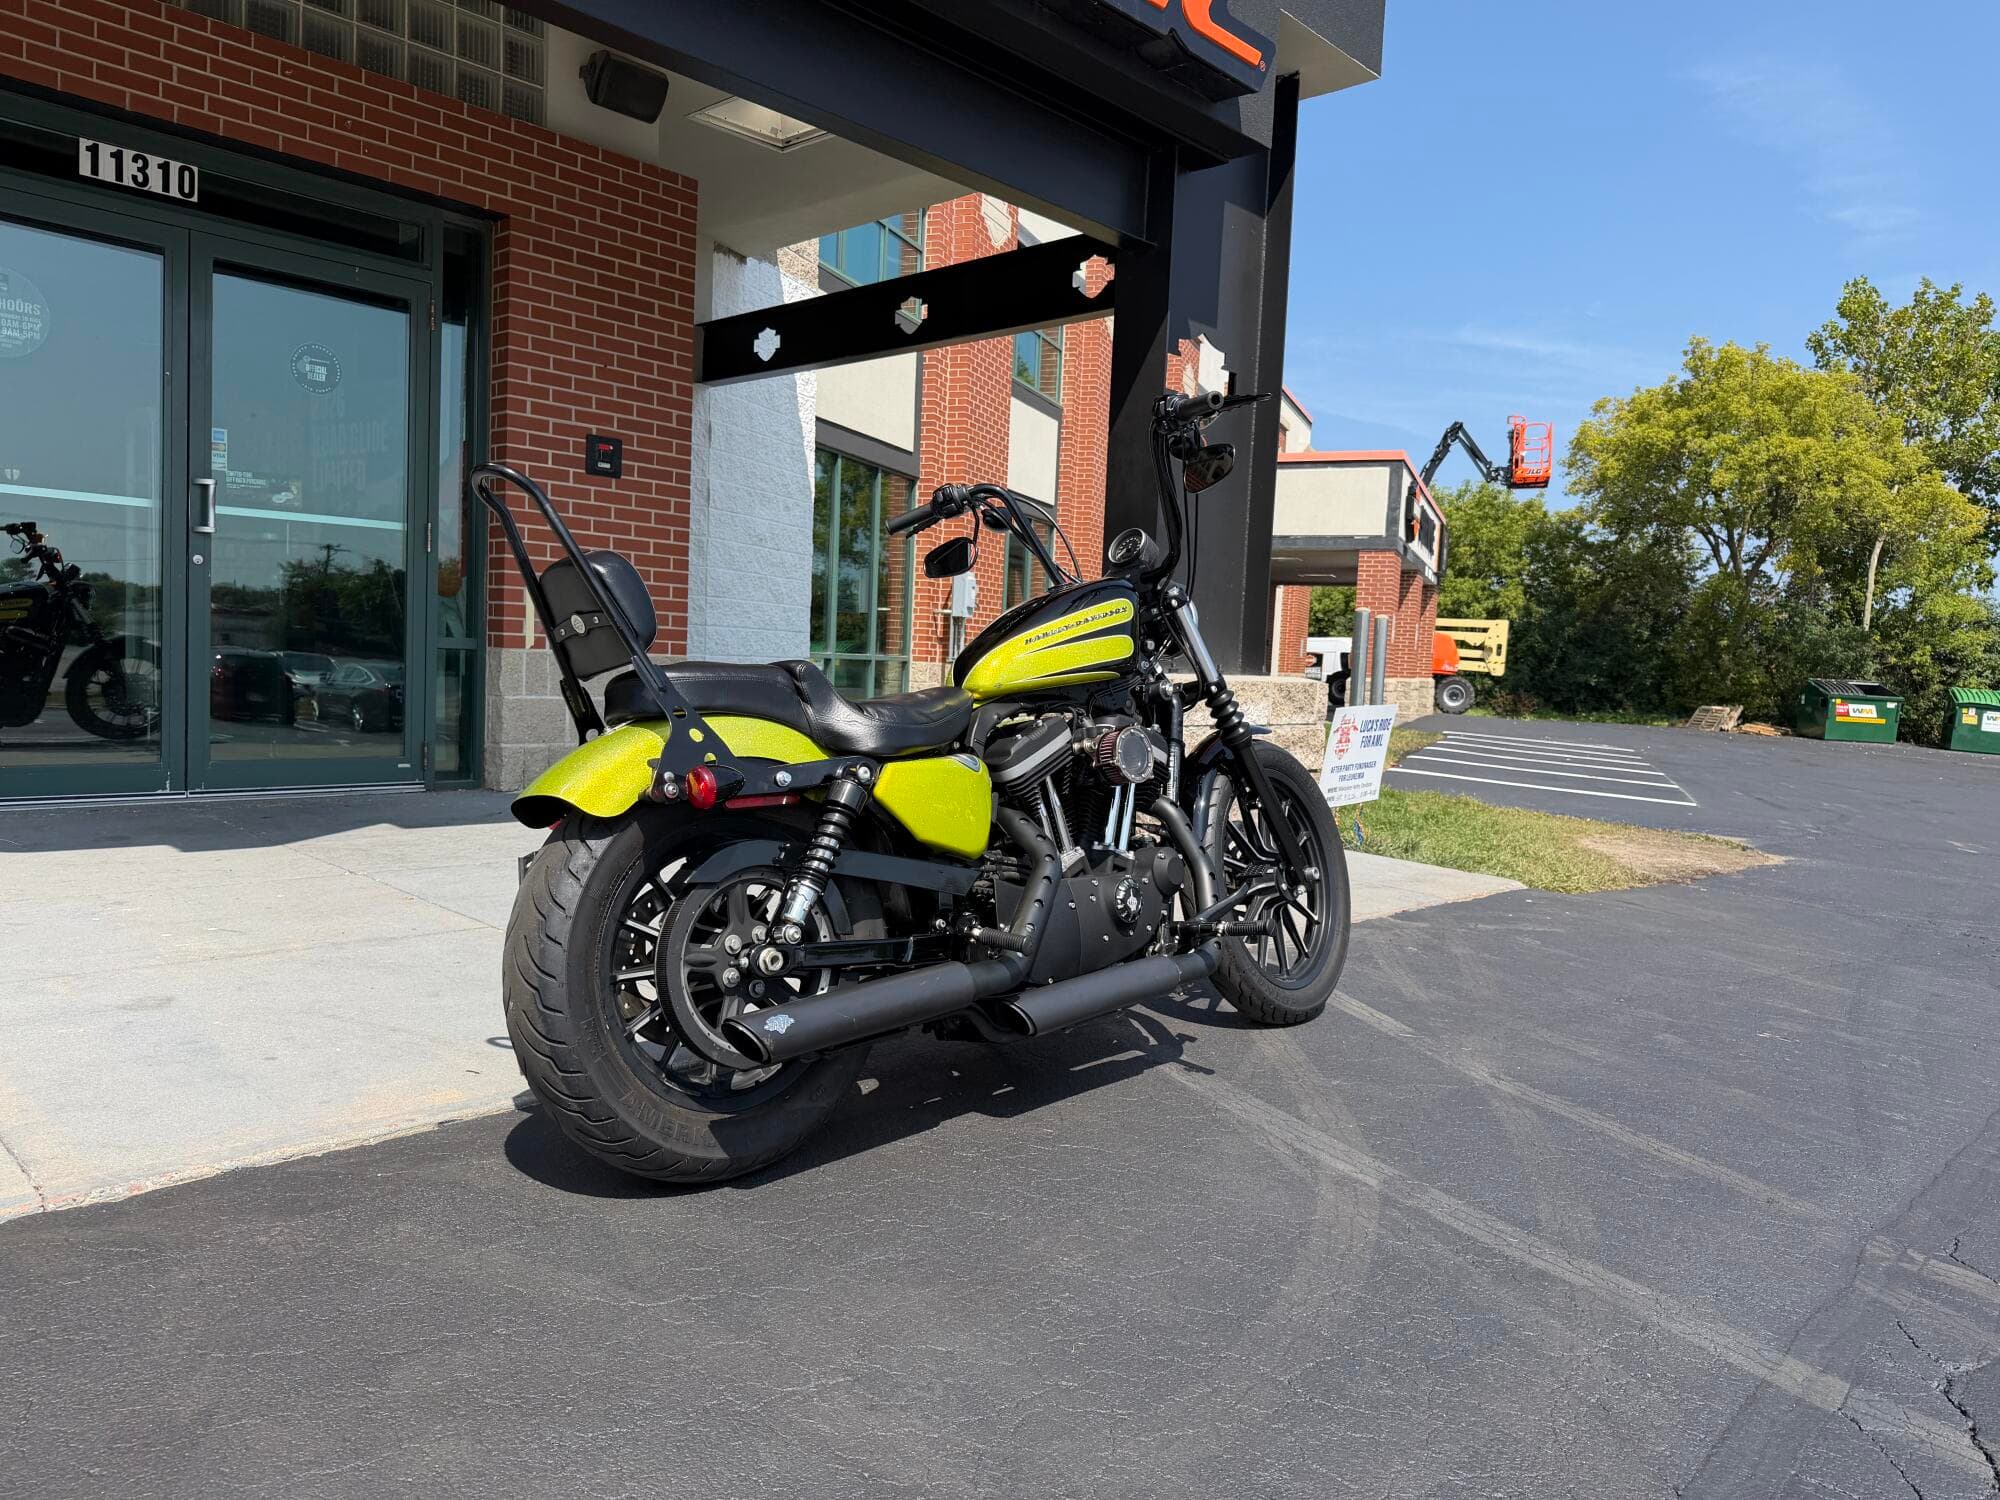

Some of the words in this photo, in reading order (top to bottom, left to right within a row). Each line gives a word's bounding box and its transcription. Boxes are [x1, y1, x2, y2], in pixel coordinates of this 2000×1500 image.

[85, 142, 196, 199] 11310
[0, 298, 41, 316] HOURS
[307, 372, 326, 382] DEALER
[1360, 719, 1379, 732] LUCA'S
[1378, 718, 1392, 731] RIDE
[1360, 735, 1372, 748] FOR
[1371, 734, 1383, 747] AML
